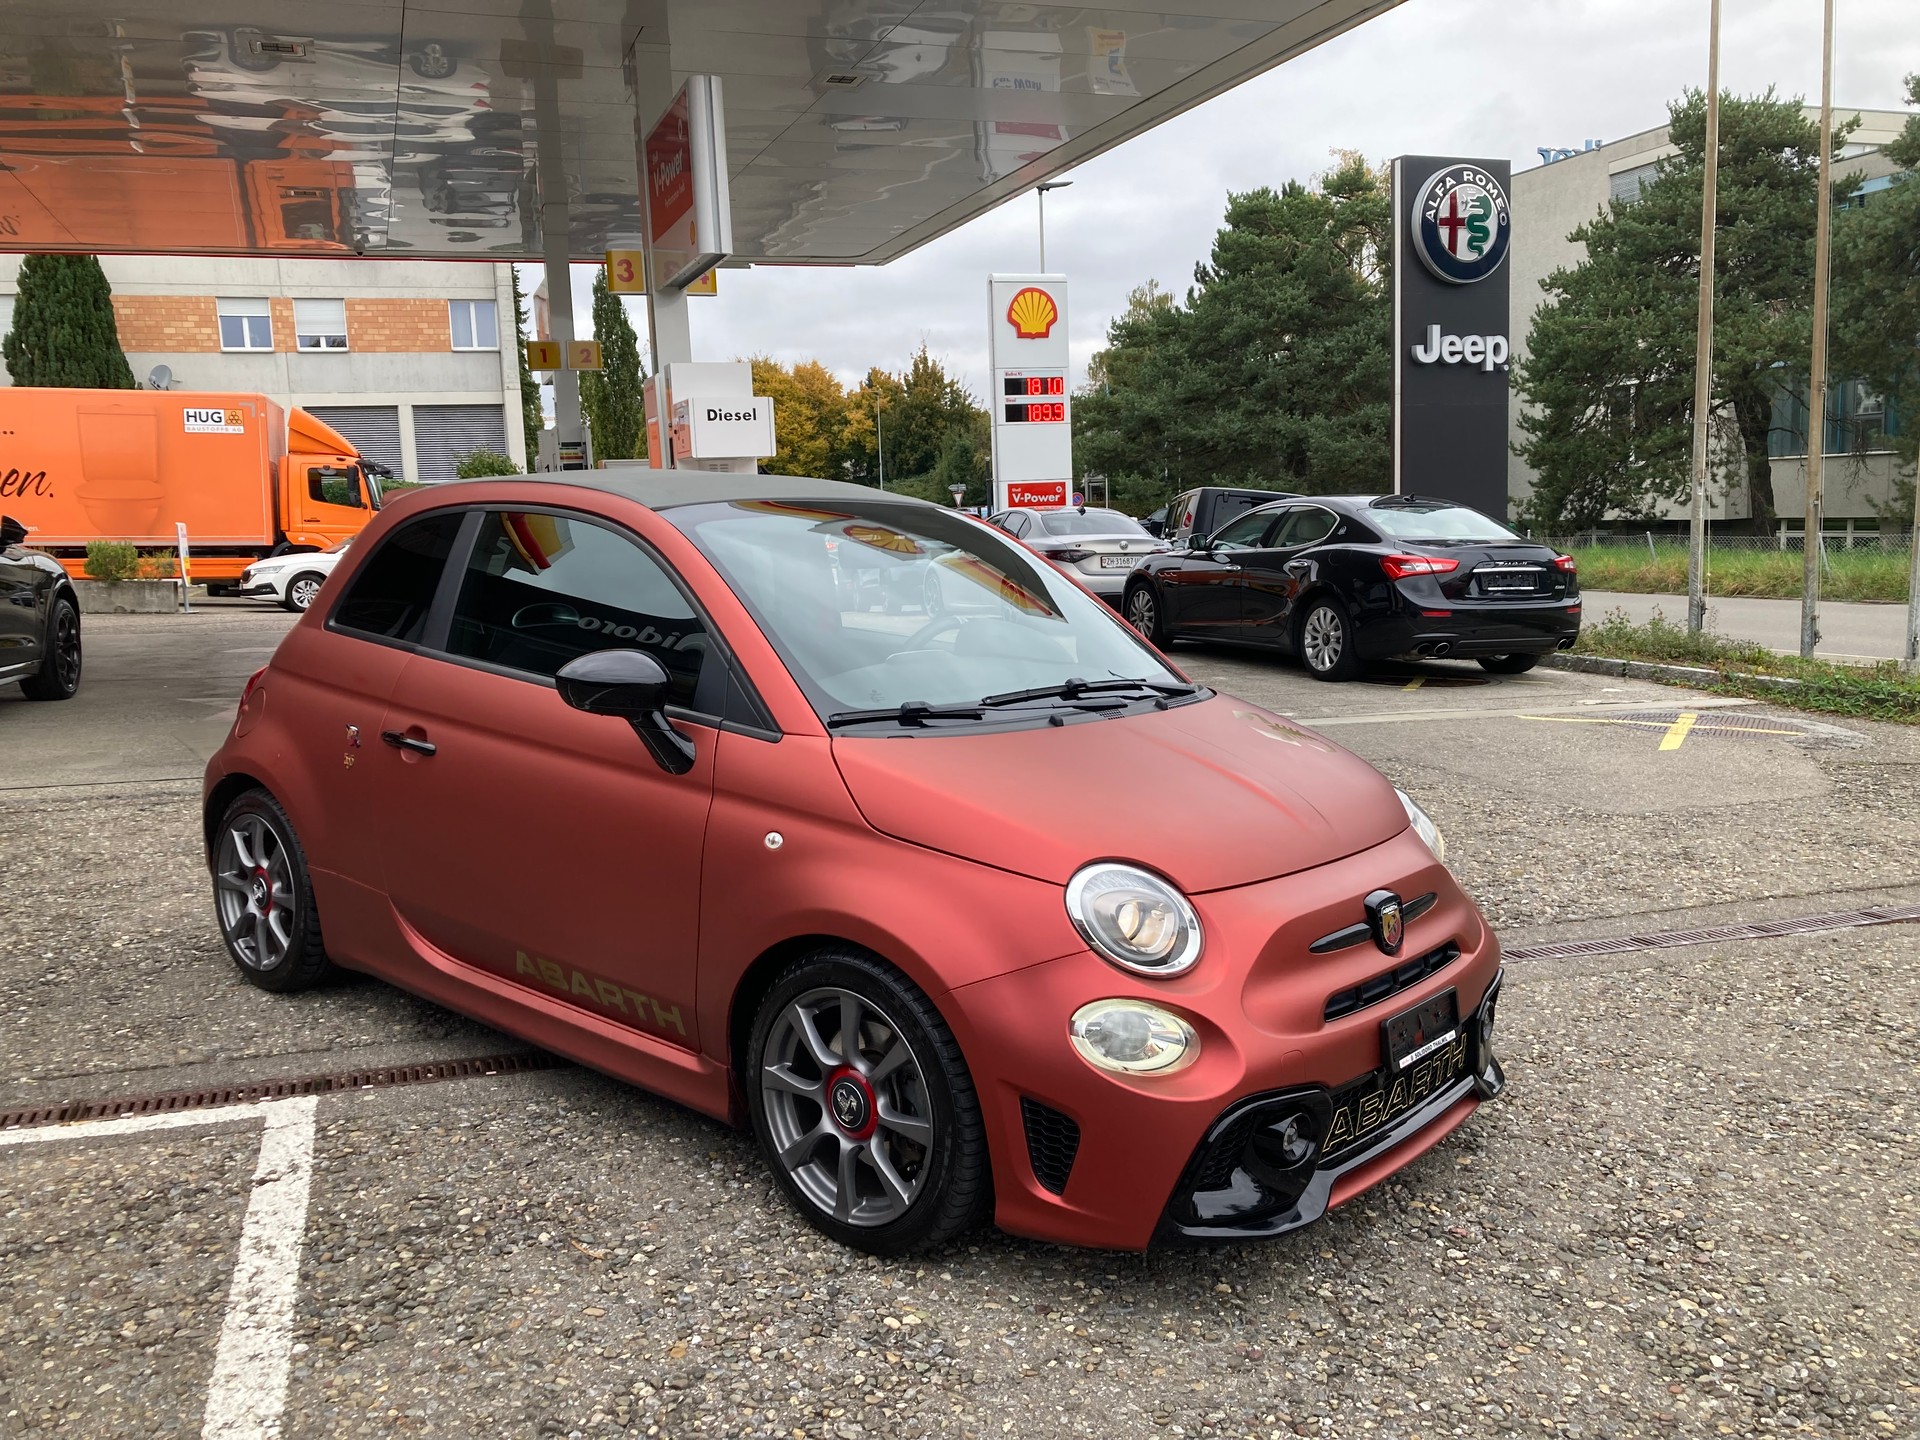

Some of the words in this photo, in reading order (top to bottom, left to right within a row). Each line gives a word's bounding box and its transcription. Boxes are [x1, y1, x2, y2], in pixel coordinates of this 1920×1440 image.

[653, 147, 683, 198] V-Power
[1425, 176, 1457, 223] ALFA
[1463, 170, 1508, 226] ROMEO
[616, 258, 635, 283] 3
[539, 348, 548, 364] 1
[579, 348, 592, 363] 2
[1411, 324, 1509, 371] Jeep
[186, 411, 223, 423] HUG
[706, 407, 757, 421] Diesel
[1028, 404, 1064, 422] 189.9
[0, 468, 54, 498] en.
[1012, 492, 1061, 504] V-Power
[516, 950, 687, 1036] ABARTH
[1322, 1033, 1467, 1153] ABARTH
